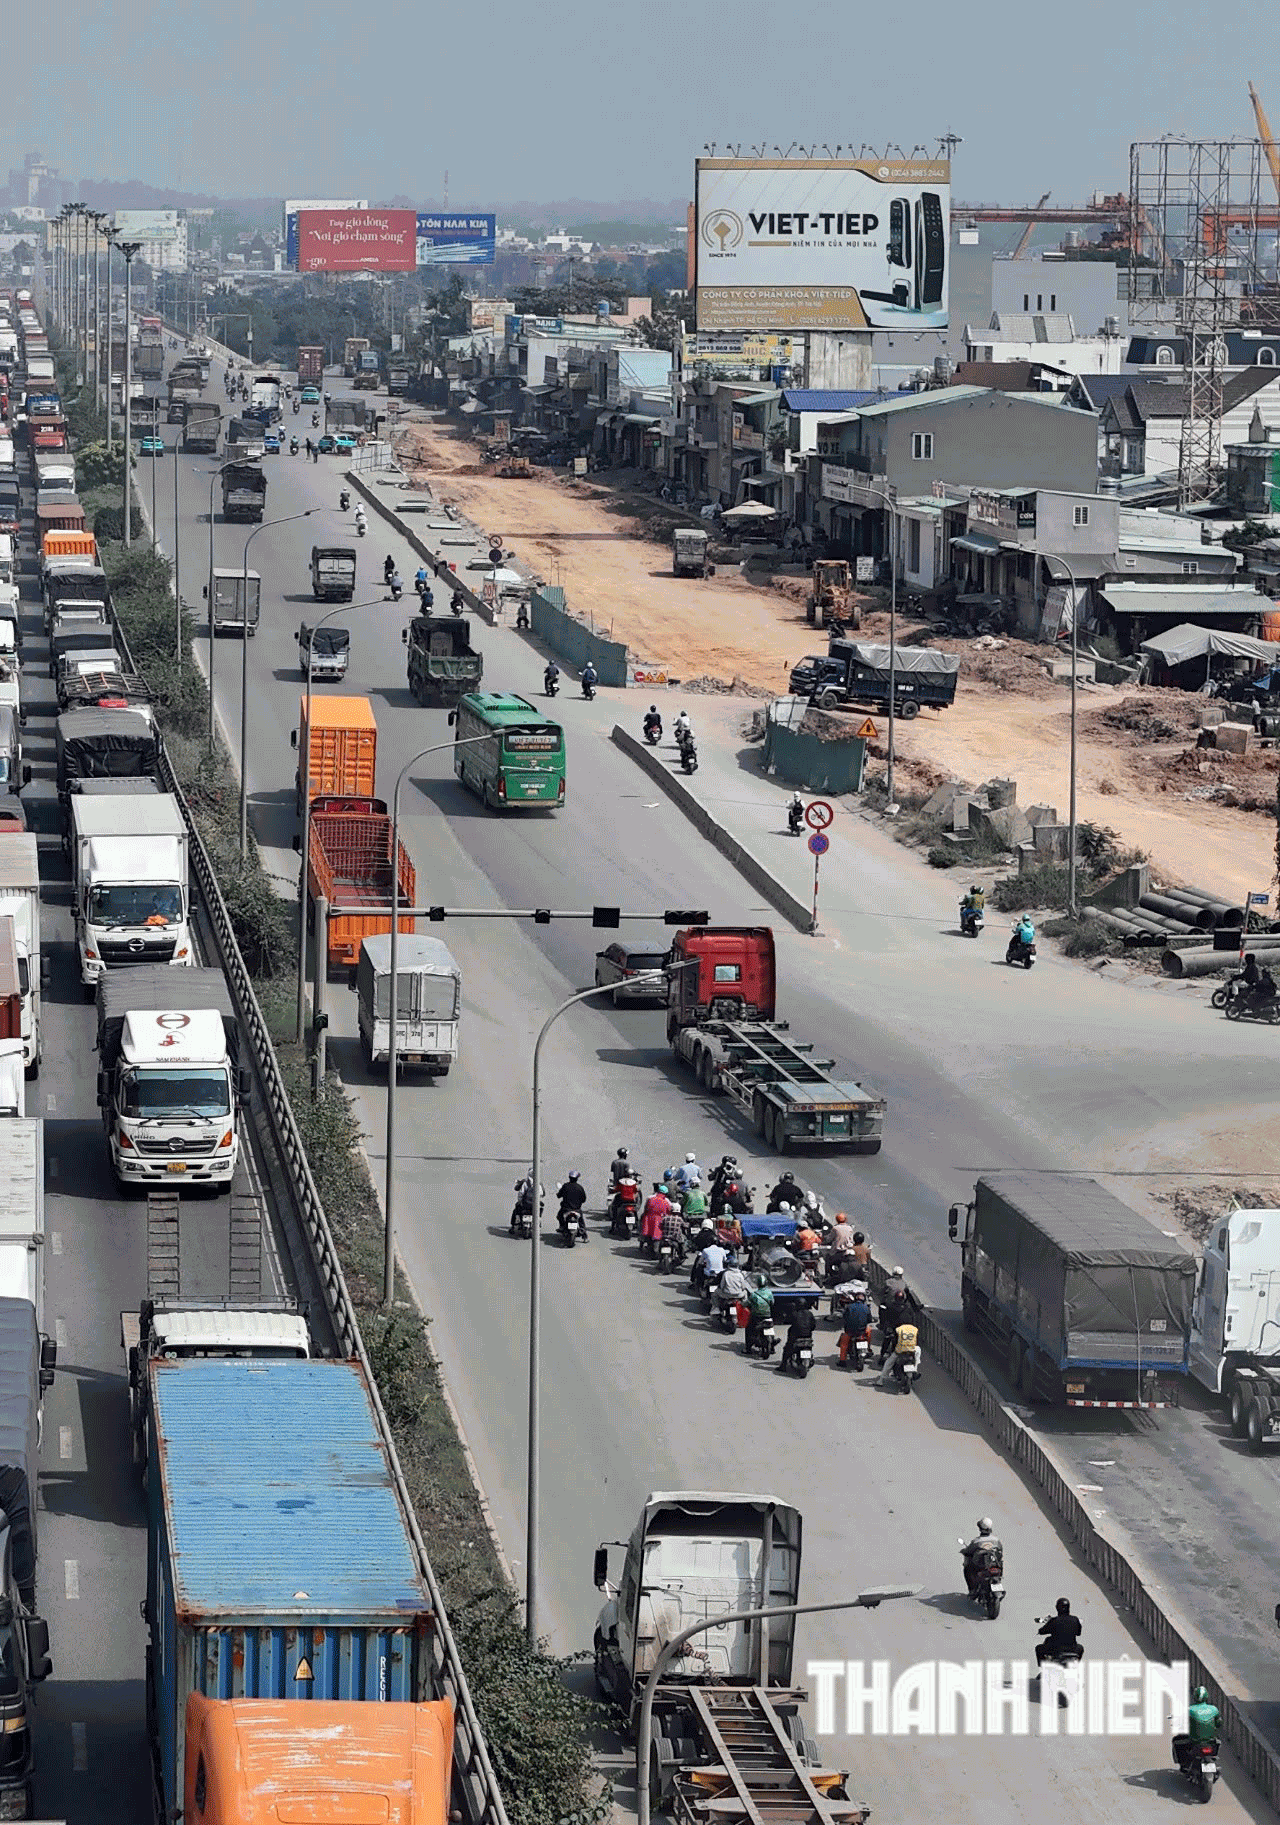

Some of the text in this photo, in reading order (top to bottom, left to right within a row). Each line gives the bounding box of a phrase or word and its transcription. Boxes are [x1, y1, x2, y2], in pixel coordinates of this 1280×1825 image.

[421, 218, 488, 228] TÔN NAM KIM
[748, 213, 879, 235] VIET-TIEP
[702, 290, 728, 299] CÔNG
[731, 291, 742, 299] TY
